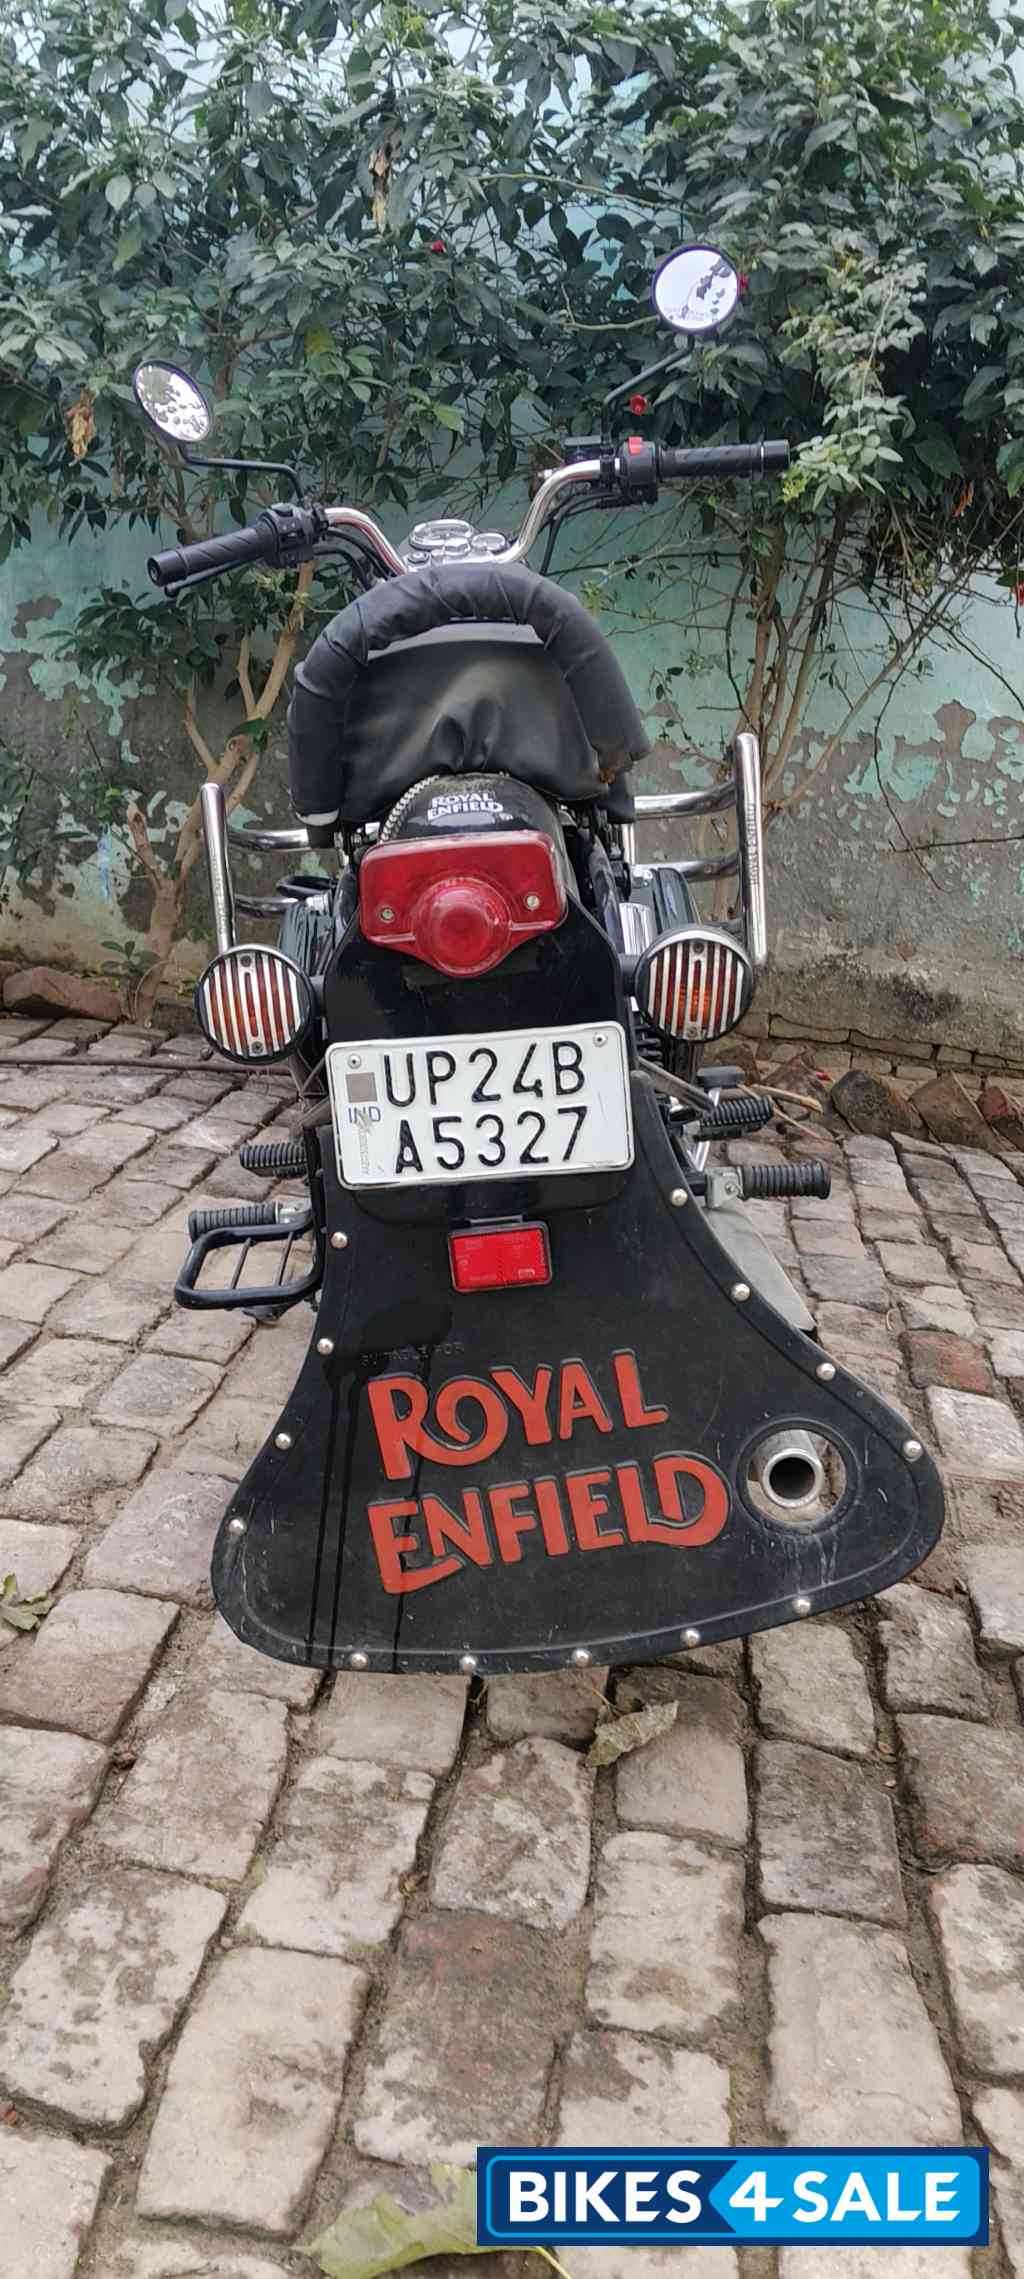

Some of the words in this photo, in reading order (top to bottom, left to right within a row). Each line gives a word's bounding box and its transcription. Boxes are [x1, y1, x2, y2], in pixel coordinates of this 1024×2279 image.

[427, 801, 503, 820] ENFIELD
[432, 793, 494, 808] ROYAL
[384, 1040, 585, 1107] UP24B
[348, 1106, 381, 1124] IND
[395, 1105, 588, 1174] A5327
[367, 1349, 669, 1480] ROYAL
[367, 1450, 732, 1594] ENFIELD
